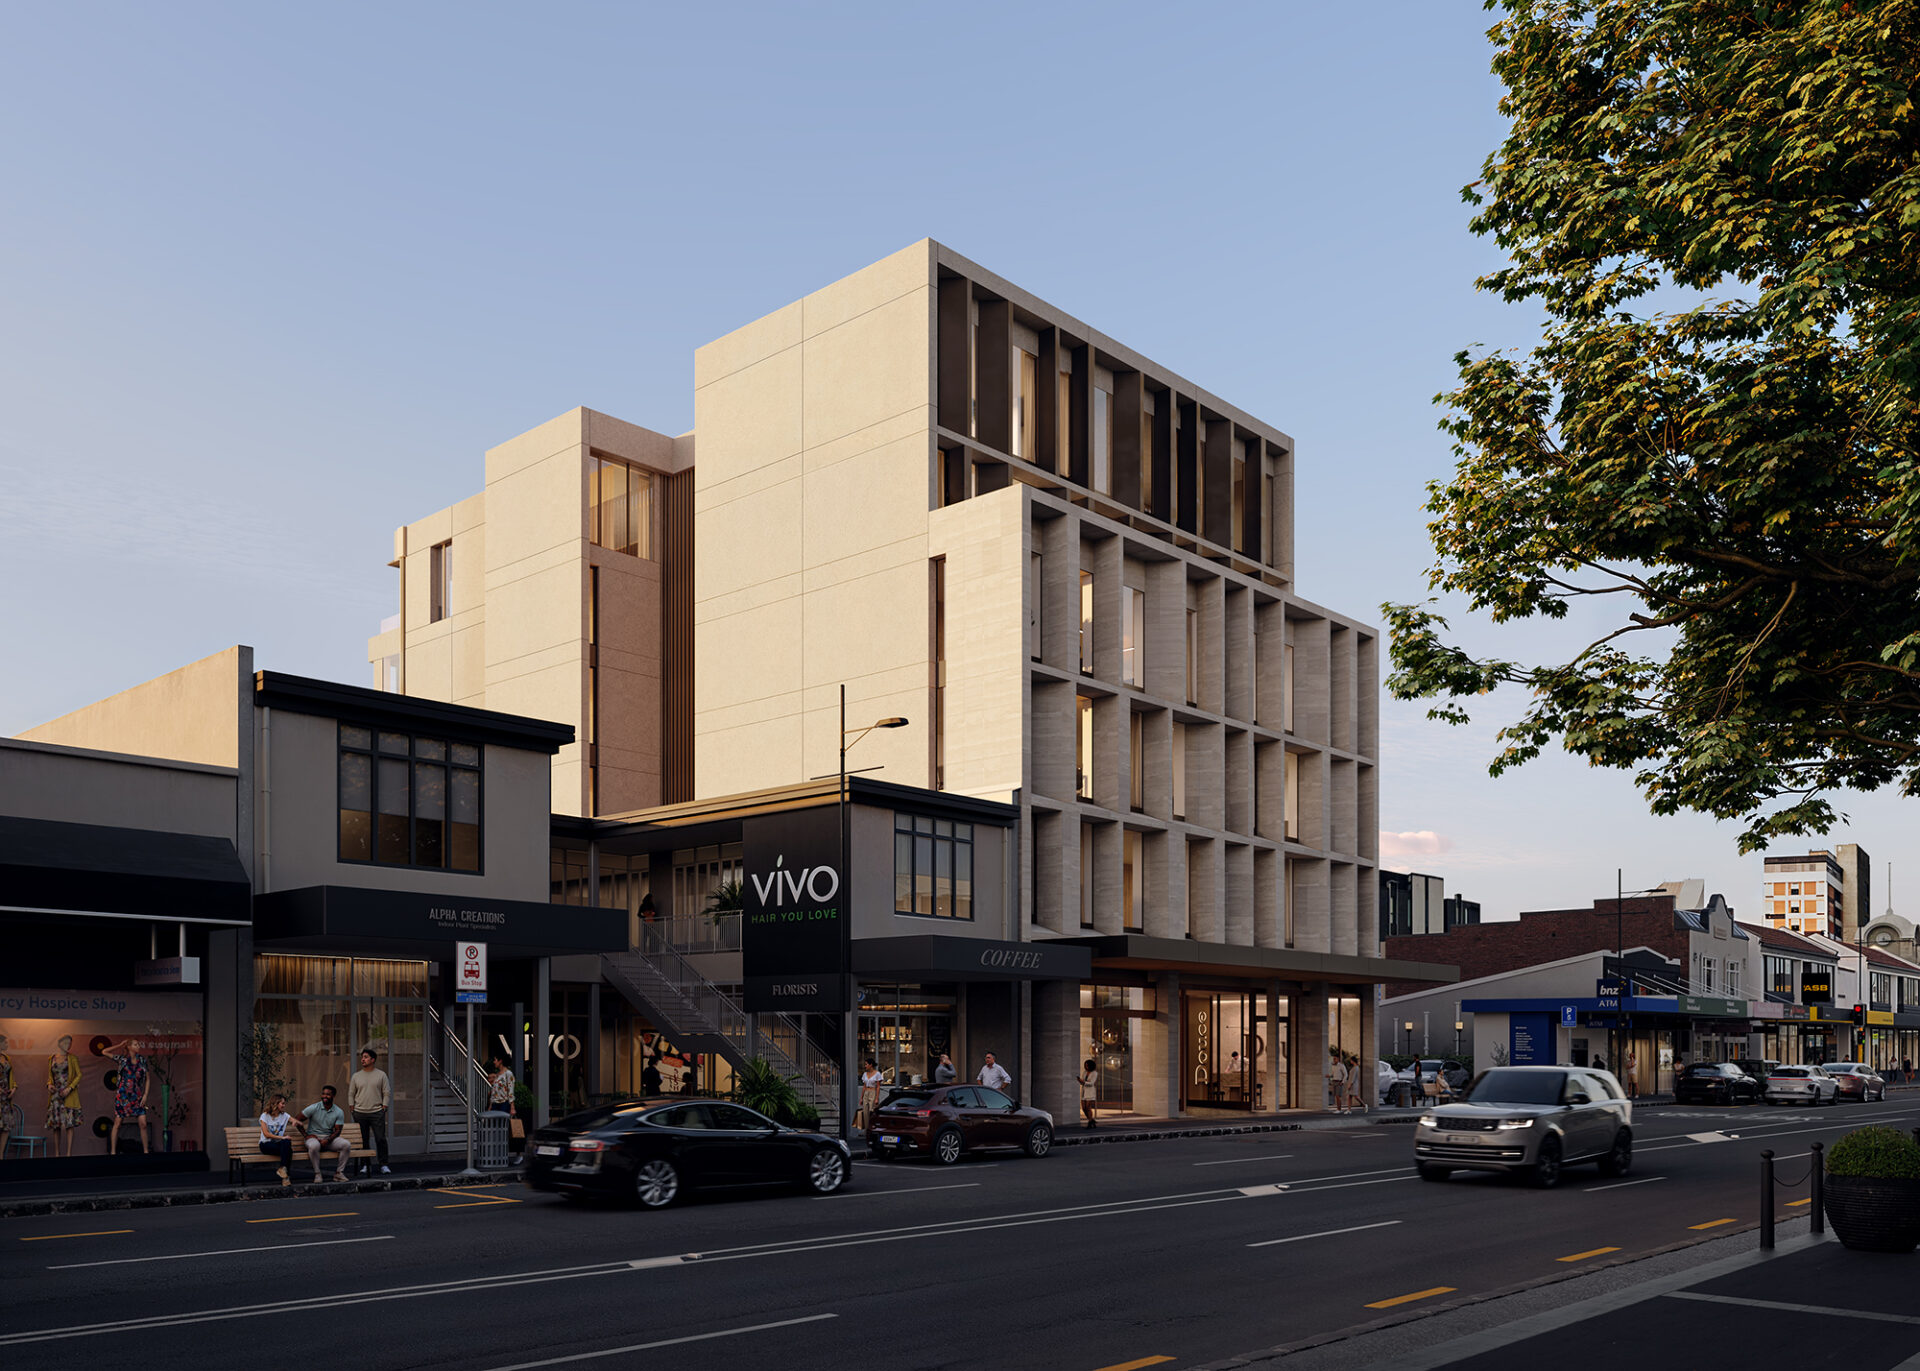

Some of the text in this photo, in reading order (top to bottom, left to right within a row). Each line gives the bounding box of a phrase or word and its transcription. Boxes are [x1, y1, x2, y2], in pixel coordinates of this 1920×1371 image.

[429, 908, 505, 924] ALPHA CREATIONS
[752, 908, 838, 924] HAIR YOU LOVE
[981, 949, 1043, 968] COFFEE
[772, 984, 818, 996] FLORISTS
[1600, 985, 1620, 995] bnz
[30, 997, 88, 1011] Hospice
[92, 998, 126, 1012] Shop
